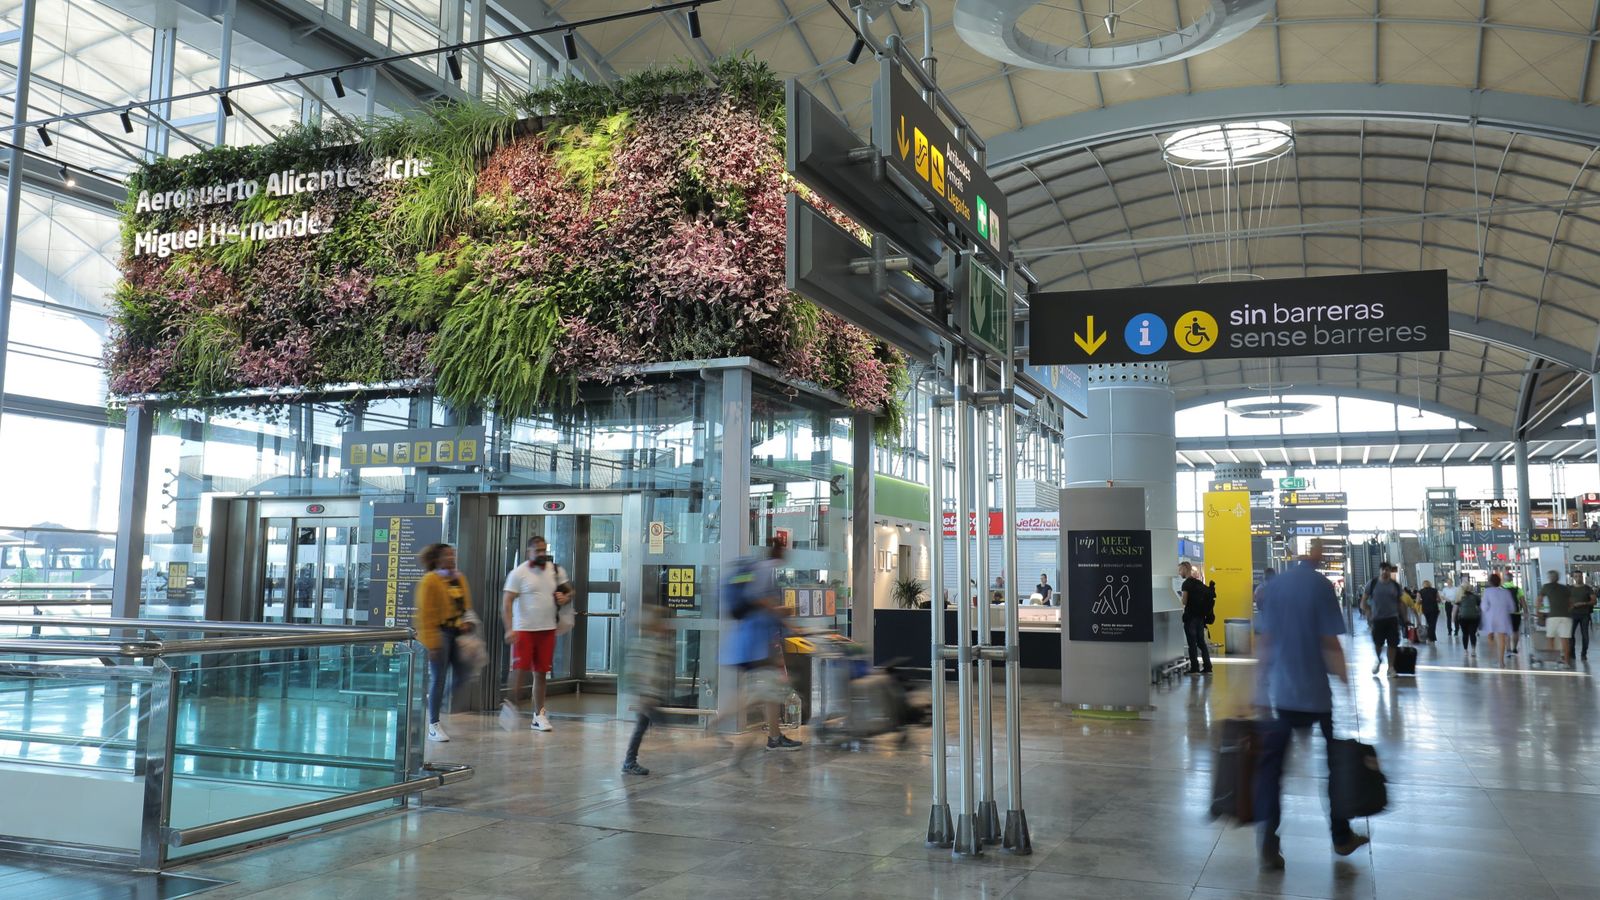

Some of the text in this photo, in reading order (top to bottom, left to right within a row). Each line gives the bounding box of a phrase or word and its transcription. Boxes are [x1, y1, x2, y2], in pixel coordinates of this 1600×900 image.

[946, 142, 971, 182] Arribades
[946, 164, 964, 193] Arrivals
[136, 177, 260, 214] Aeropuerto
[947, 183, 971, 221] Llegadas
[134, 210, 334, 258] Miguel Hernande
[1229, 300, 1385, 326] sin barreras
[1229, 324, 1428, 349] sense barreres
[1079, 536, 1131, 549] vip MEET
[1101, 546, 1144, 555] & ASSIST
